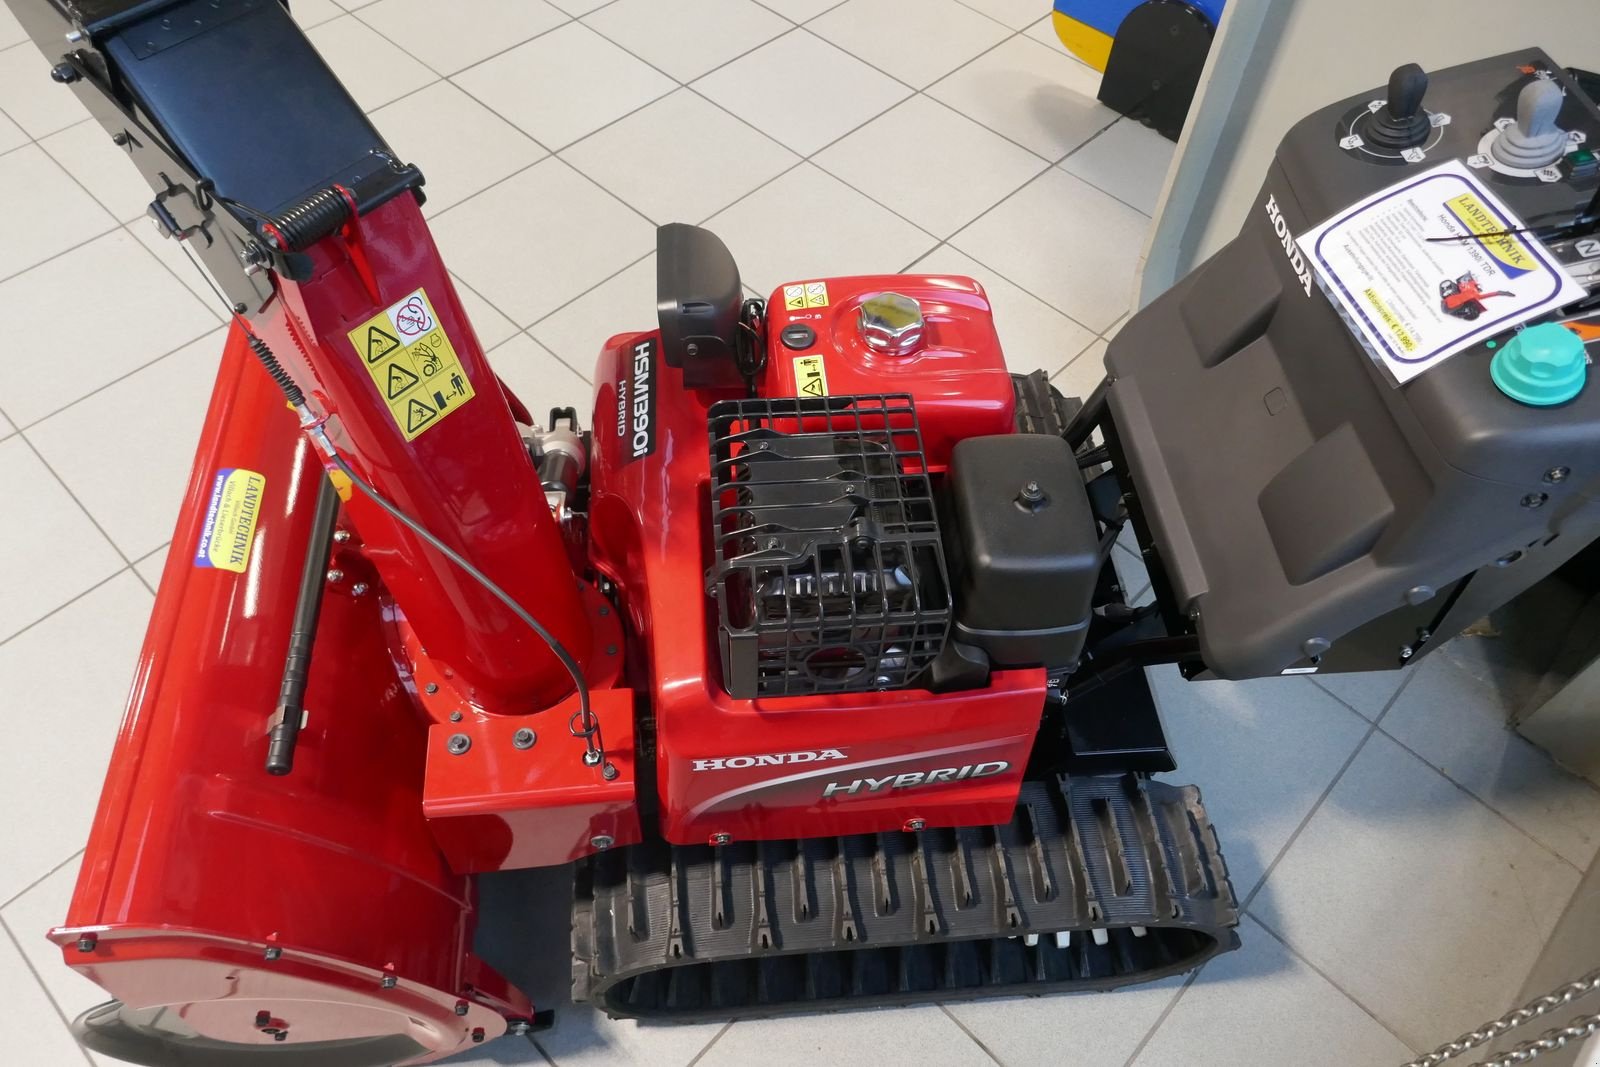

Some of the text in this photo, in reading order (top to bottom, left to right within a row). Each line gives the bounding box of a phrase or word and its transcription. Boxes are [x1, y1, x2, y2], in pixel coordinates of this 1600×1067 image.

[1266, 194, 1314, 297] HONDA
[1438, 214, 1456, 233] Honda
[1455, 232, 1470, 246] HM
[1480, 260, 1496, 276] TDR
[617, 380, 627, 437] HYBRID
[633, 342, 650, 458] HSM1390i
[226, 480, 236, 502] Villach
[213, 509, 229, 552] Lieserbrücke
[230, 476, 261, 565] LANDTECHNIK
[693, 749, 847, 771] HONDA
[822, 760, 1009, 797] HYBRID
